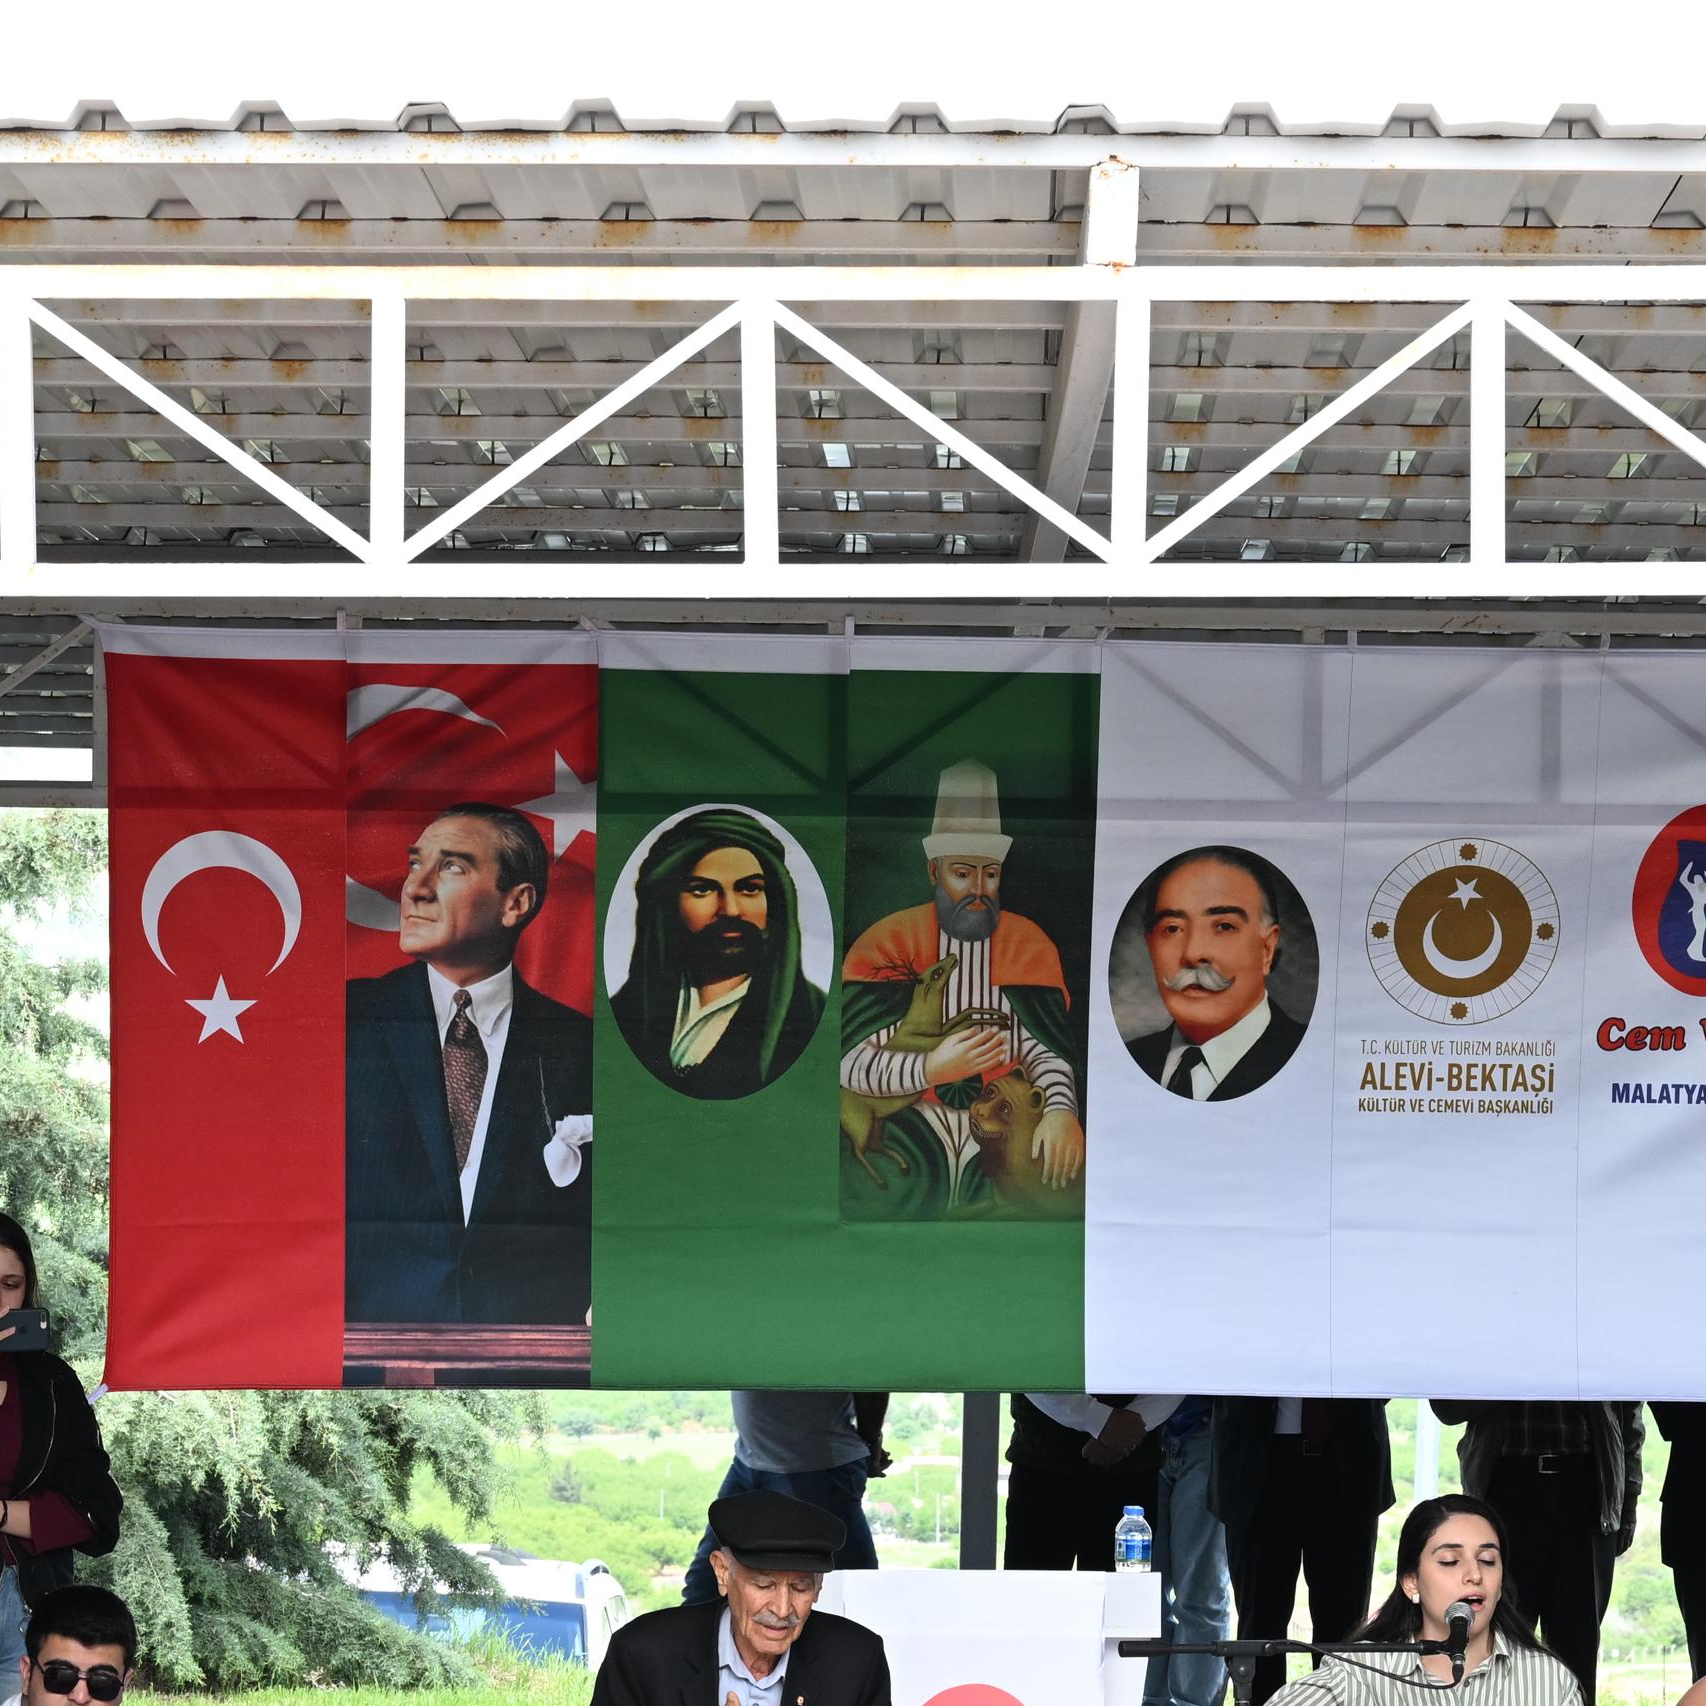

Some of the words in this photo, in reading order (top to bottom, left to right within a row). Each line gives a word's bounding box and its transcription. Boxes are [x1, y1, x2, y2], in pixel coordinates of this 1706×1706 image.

[1596, 1016, 1686, 1053] Cem
[1360, 1040, 1381, 1055] T.C.
[1385, 1040, 1426, 1055] KÜLTÜR
[1431, 1041, 1445, 1056] VE
[1496, 1040, 1556, 1057] BAKANLIĞI
[1358, 1097, 1405, 1112] KÜLTÜR
[1409, 1099, 1424, 1112] VE
[1477, 1098, 1554, 1117] BAŞKANLIĞI
